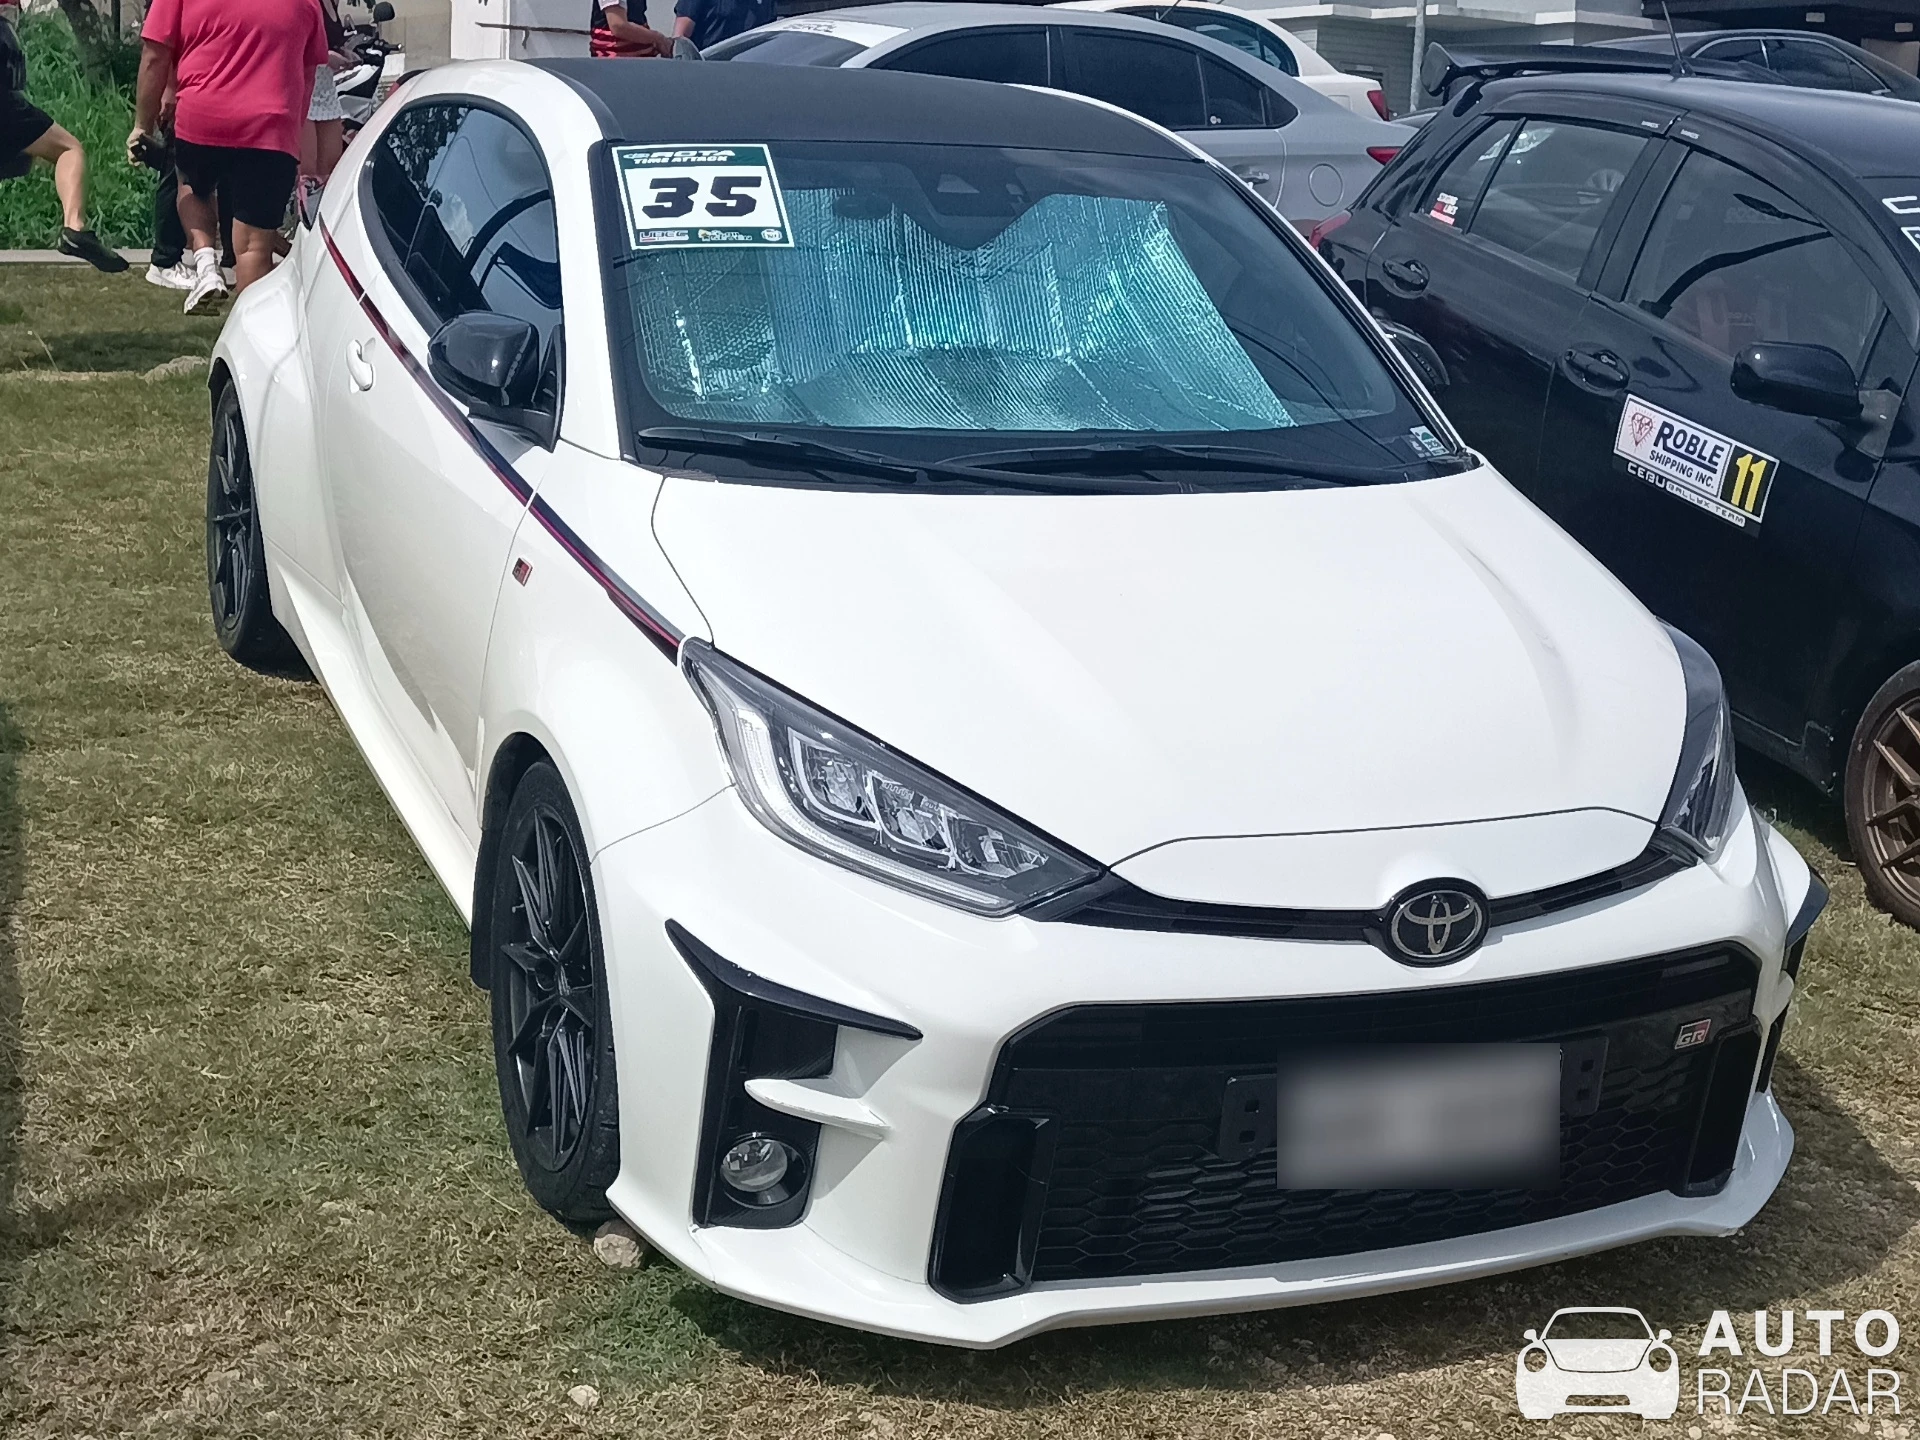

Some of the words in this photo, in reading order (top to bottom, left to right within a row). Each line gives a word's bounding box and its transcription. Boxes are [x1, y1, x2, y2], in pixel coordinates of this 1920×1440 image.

[633, 157, 670, 165] TIME
[671, 155, 728, 163] ATTACK
[650, 150, 736, 158] ROTA
[641, 176, 763, 219] 35
[1653, 421, 1725, 470] ROBLE
[1649, 450, 1694, 478] SHIPPING
[1695, 471, 1714, 489] INC.
[1730, 453, 1768, 513] 11
[1627, 462, 1666, 489] CEBU
[1714, 505, 1744, 525] TEAM
[1677, 1029, 1706, 1046] GR
